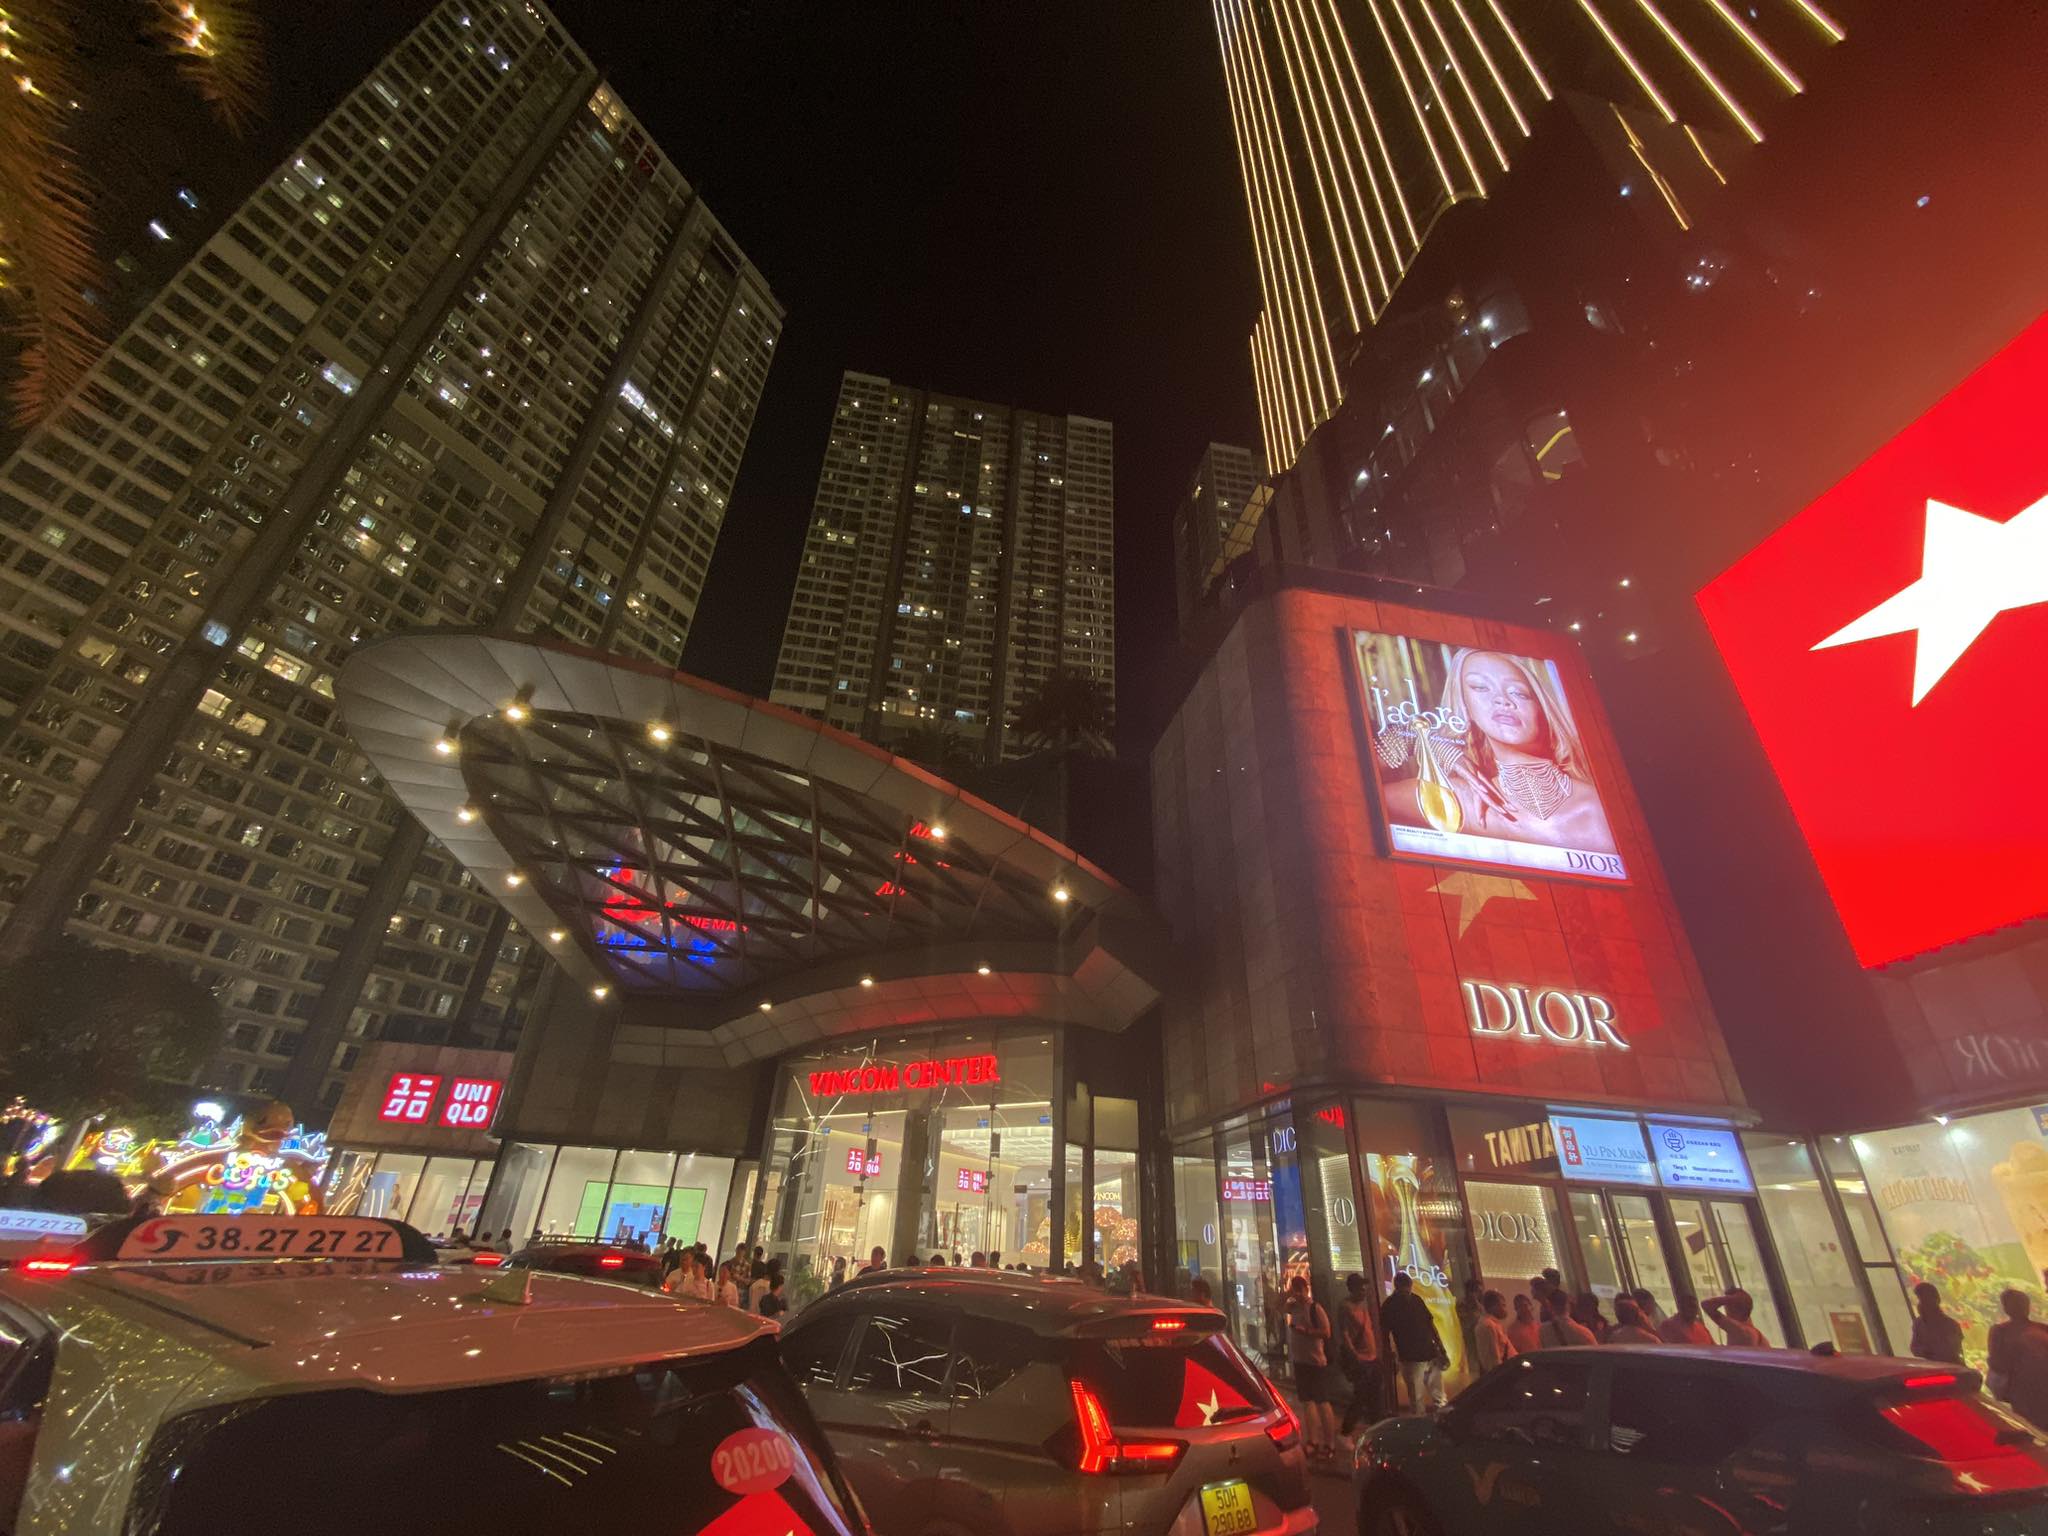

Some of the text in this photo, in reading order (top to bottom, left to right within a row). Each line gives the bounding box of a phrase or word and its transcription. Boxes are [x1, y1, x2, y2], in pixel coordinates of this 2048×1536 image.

[1565, 851, 1623, 875] DIOR
[1463, 981, 1631, 1049] DIOR
[393, 1077, 434, 1097] ユニ
[808, 1055, 1001, 1097] VINCOM CENTER
[453, 1082, 493, 1103] UNI
[446, 1102, 489, 1124] QLO
[40, 1219, 59, 1229] 27
[63, 1221, 83, 1231] 27
[1471, 1208, 1545, 1244] DIOR
[196, 1226, 393, 1254] 38.27 27 27
